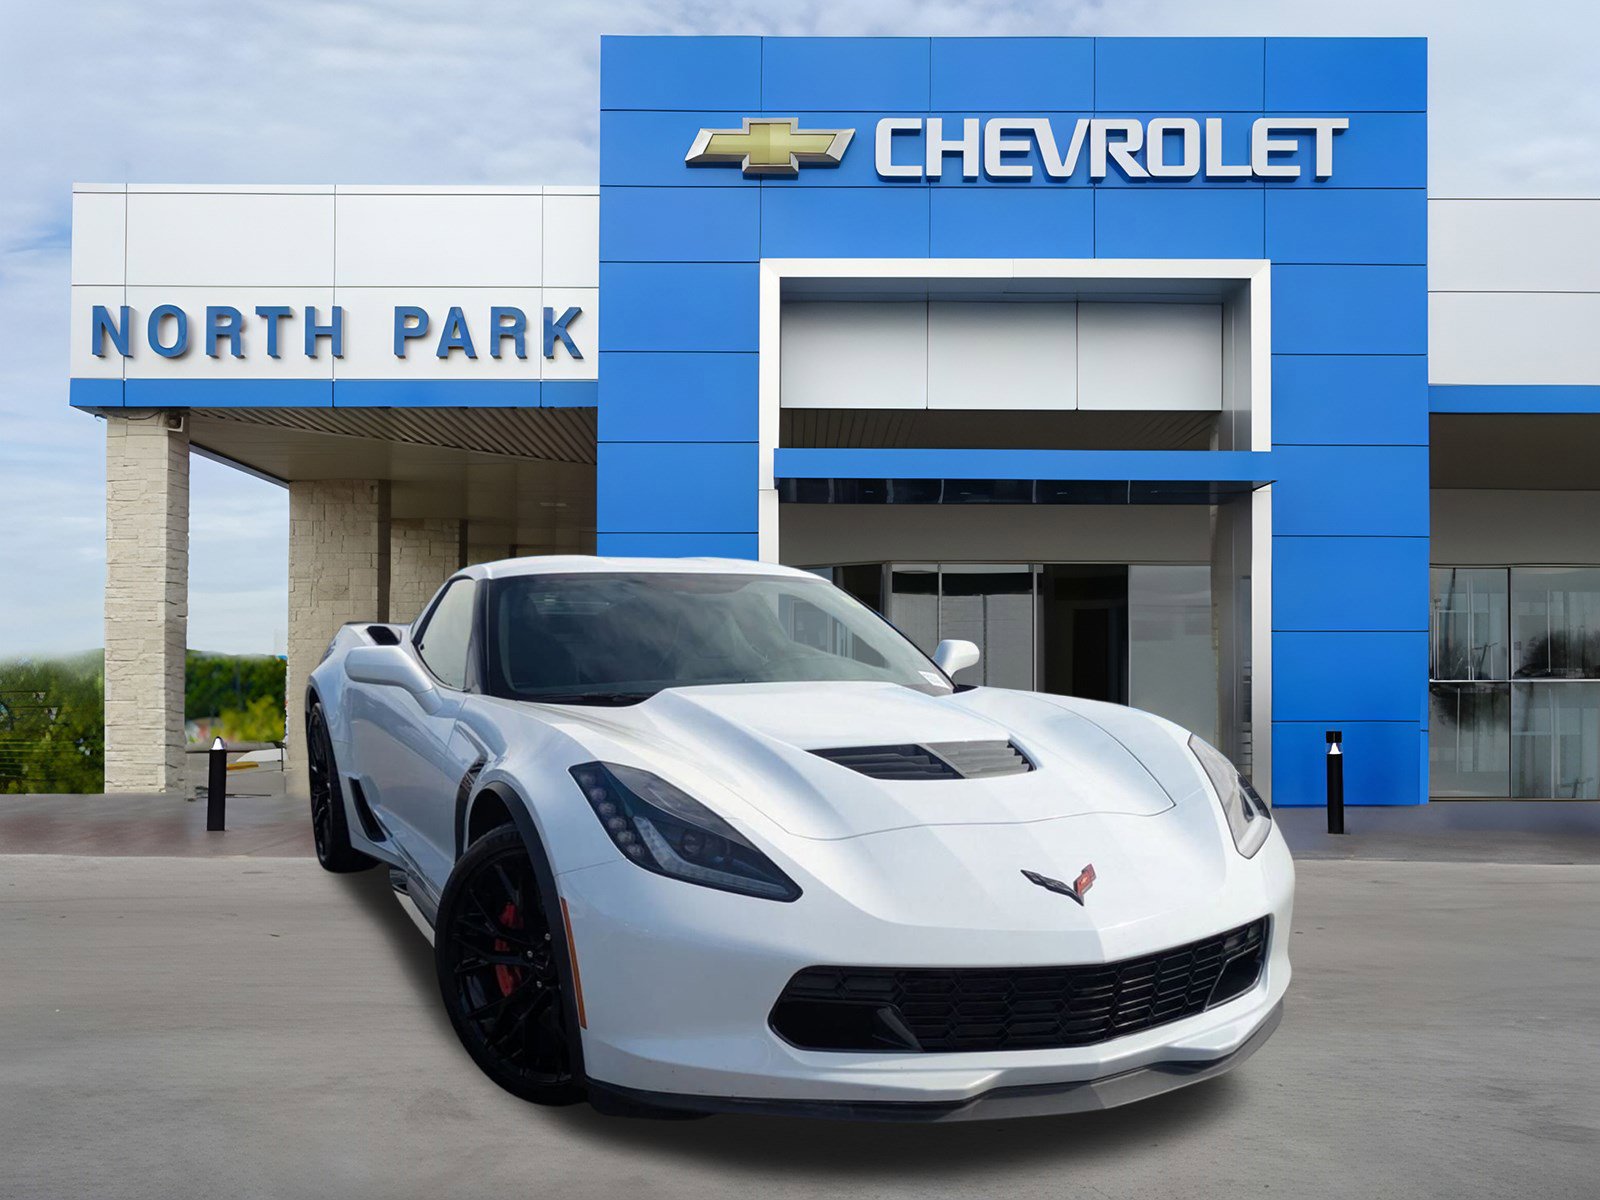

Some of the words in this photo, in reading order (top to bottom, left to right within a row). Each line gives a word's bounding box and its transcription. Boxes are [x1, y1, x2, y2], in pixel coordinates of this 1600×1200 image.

[875, 116, 1350, 180] CHEVROLET
[91, 303, 346, 360] NORTH
[393, 305, 585, 360] PARK
